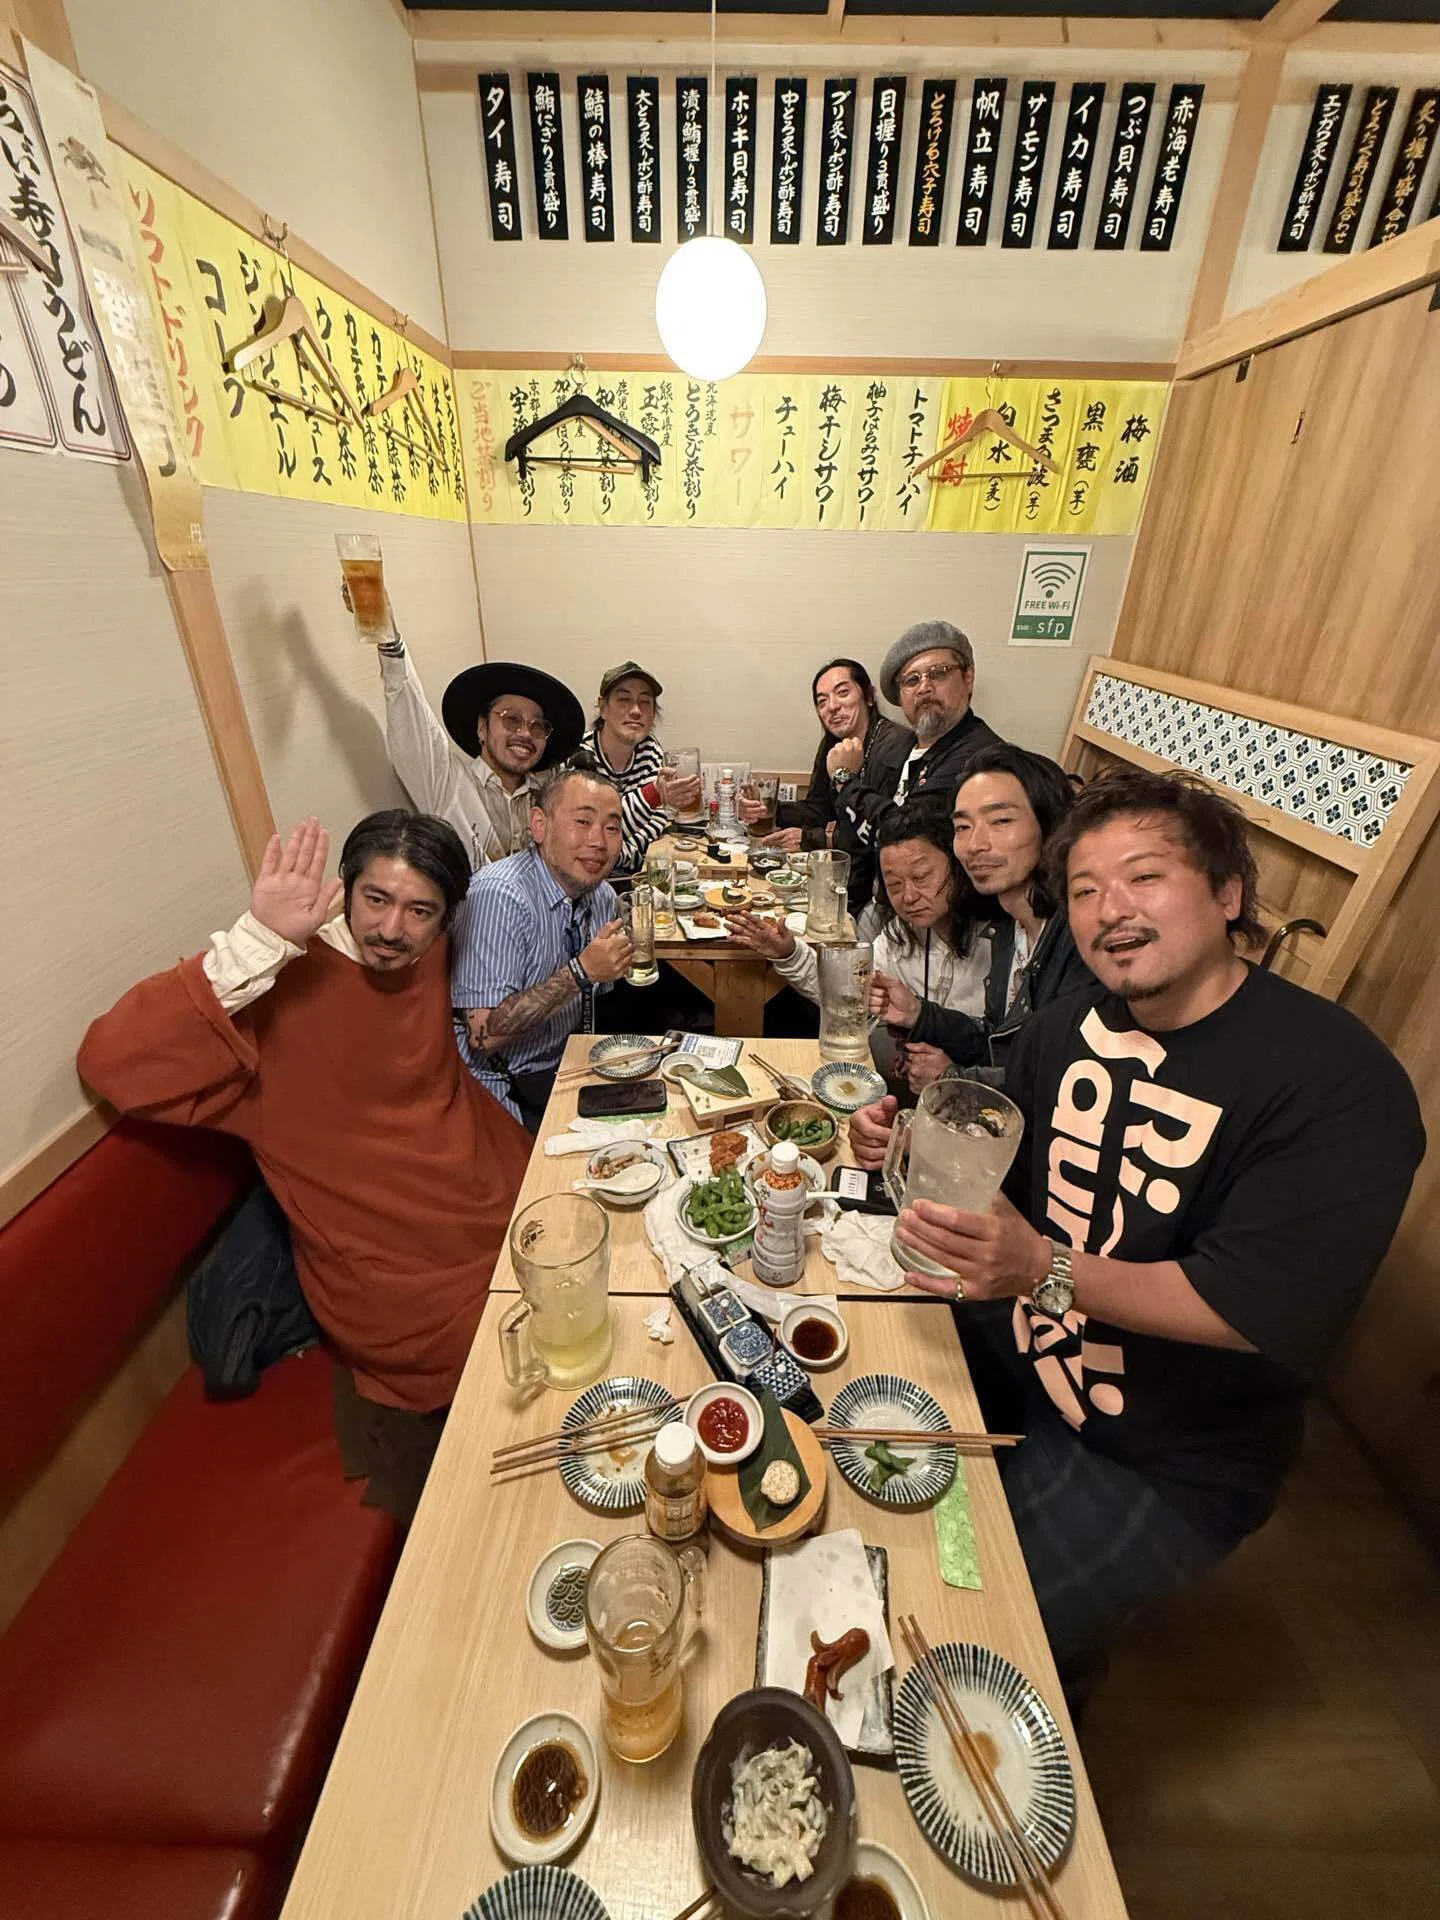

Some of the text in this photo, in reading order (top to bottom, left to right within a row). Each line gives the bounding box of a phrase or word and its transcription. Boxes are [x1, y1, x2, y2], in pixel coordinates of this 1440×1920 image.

[487, 86, 513, 231] タイ寿司
[535, 85, 560, 229] 鮪にぎり3貫盛り
[584, 88, 608, 232] 鯖の棒寿司
[635, 89, 655, 232] 大とろ炙りポン酢寿司
[682, 89, 702, 236] 漬け鮪握り3貫盛り
[730, 90, 750, 235] ホッキ貝寿司
[777, 90, 799, 235] 中とろ炙りポン酢寿司
[824, 90, 852, 236] ブリ炙りポン酢寿司
[871, 88, 897, 235] 貝握り3貫盛り
[917, 91, 947, 235] とろける穴子寿司
[965, 90, 1000, 235] 帆立寿司
[1011, 93, 1047, 238] サーモン寿司
[1056, 95, 1095, 239] イカ寿司
[1104, 96, 1146, 239] つぶ貝寿司
[1149, 95, 1195, 241] 赤海老寿司
[1289, 94, 1342, 240] エンガワ炙りポン酢寿司
[129, 182, 204, 457] ソフトドリンク
[196, 258, 245, 418] コーク
[681, 379, 705, 519] とうきび茶割り
[729, 406, 754, 507] サワー
[770, 395, 798, 500] チューハイ
[814, 383, 847, 523] 梅干しサワー
[857, 380, 888, 523] 柚子はちみつサワー
[1112, 413, 1152, 485] 梅酒
[1024, 600, 1071, 610] FREE Wi-Fi
[1037, 618, 1065, 638] sfp
